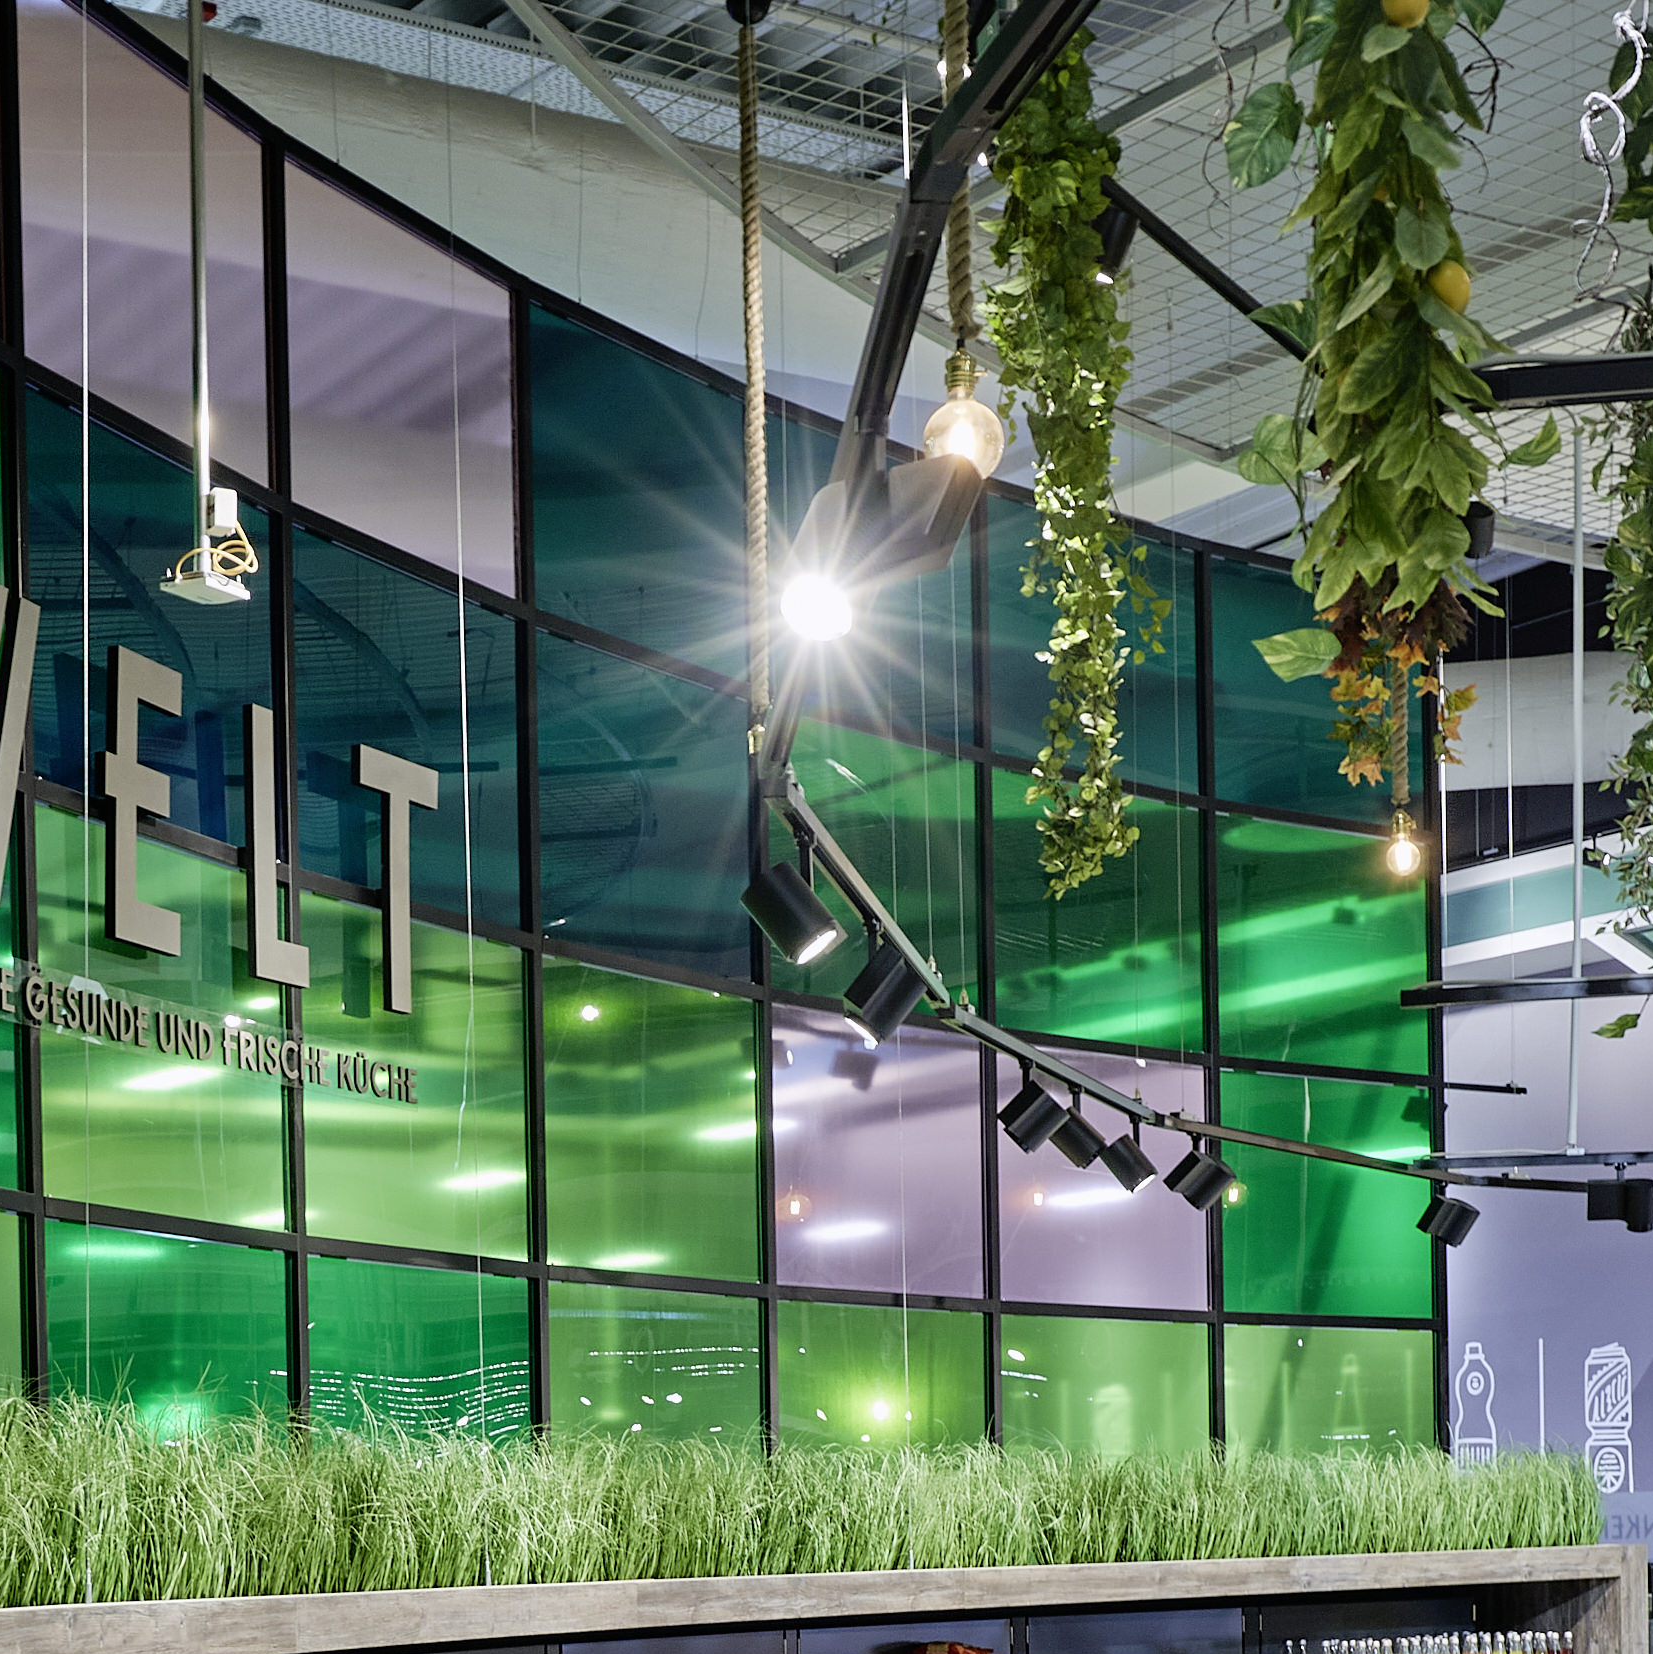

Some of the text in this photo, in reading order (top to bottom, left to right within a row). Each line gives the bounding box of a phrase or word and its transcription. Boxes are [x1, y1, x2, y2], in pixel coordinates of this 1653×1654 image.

[26, 975, 148, 1048] GESUNDE
[156, 1011, 213, 1061] UND
[222, 1028, 332, 1087] FRISCHE
[337, 1051, 419, 1104] KÜCHE
